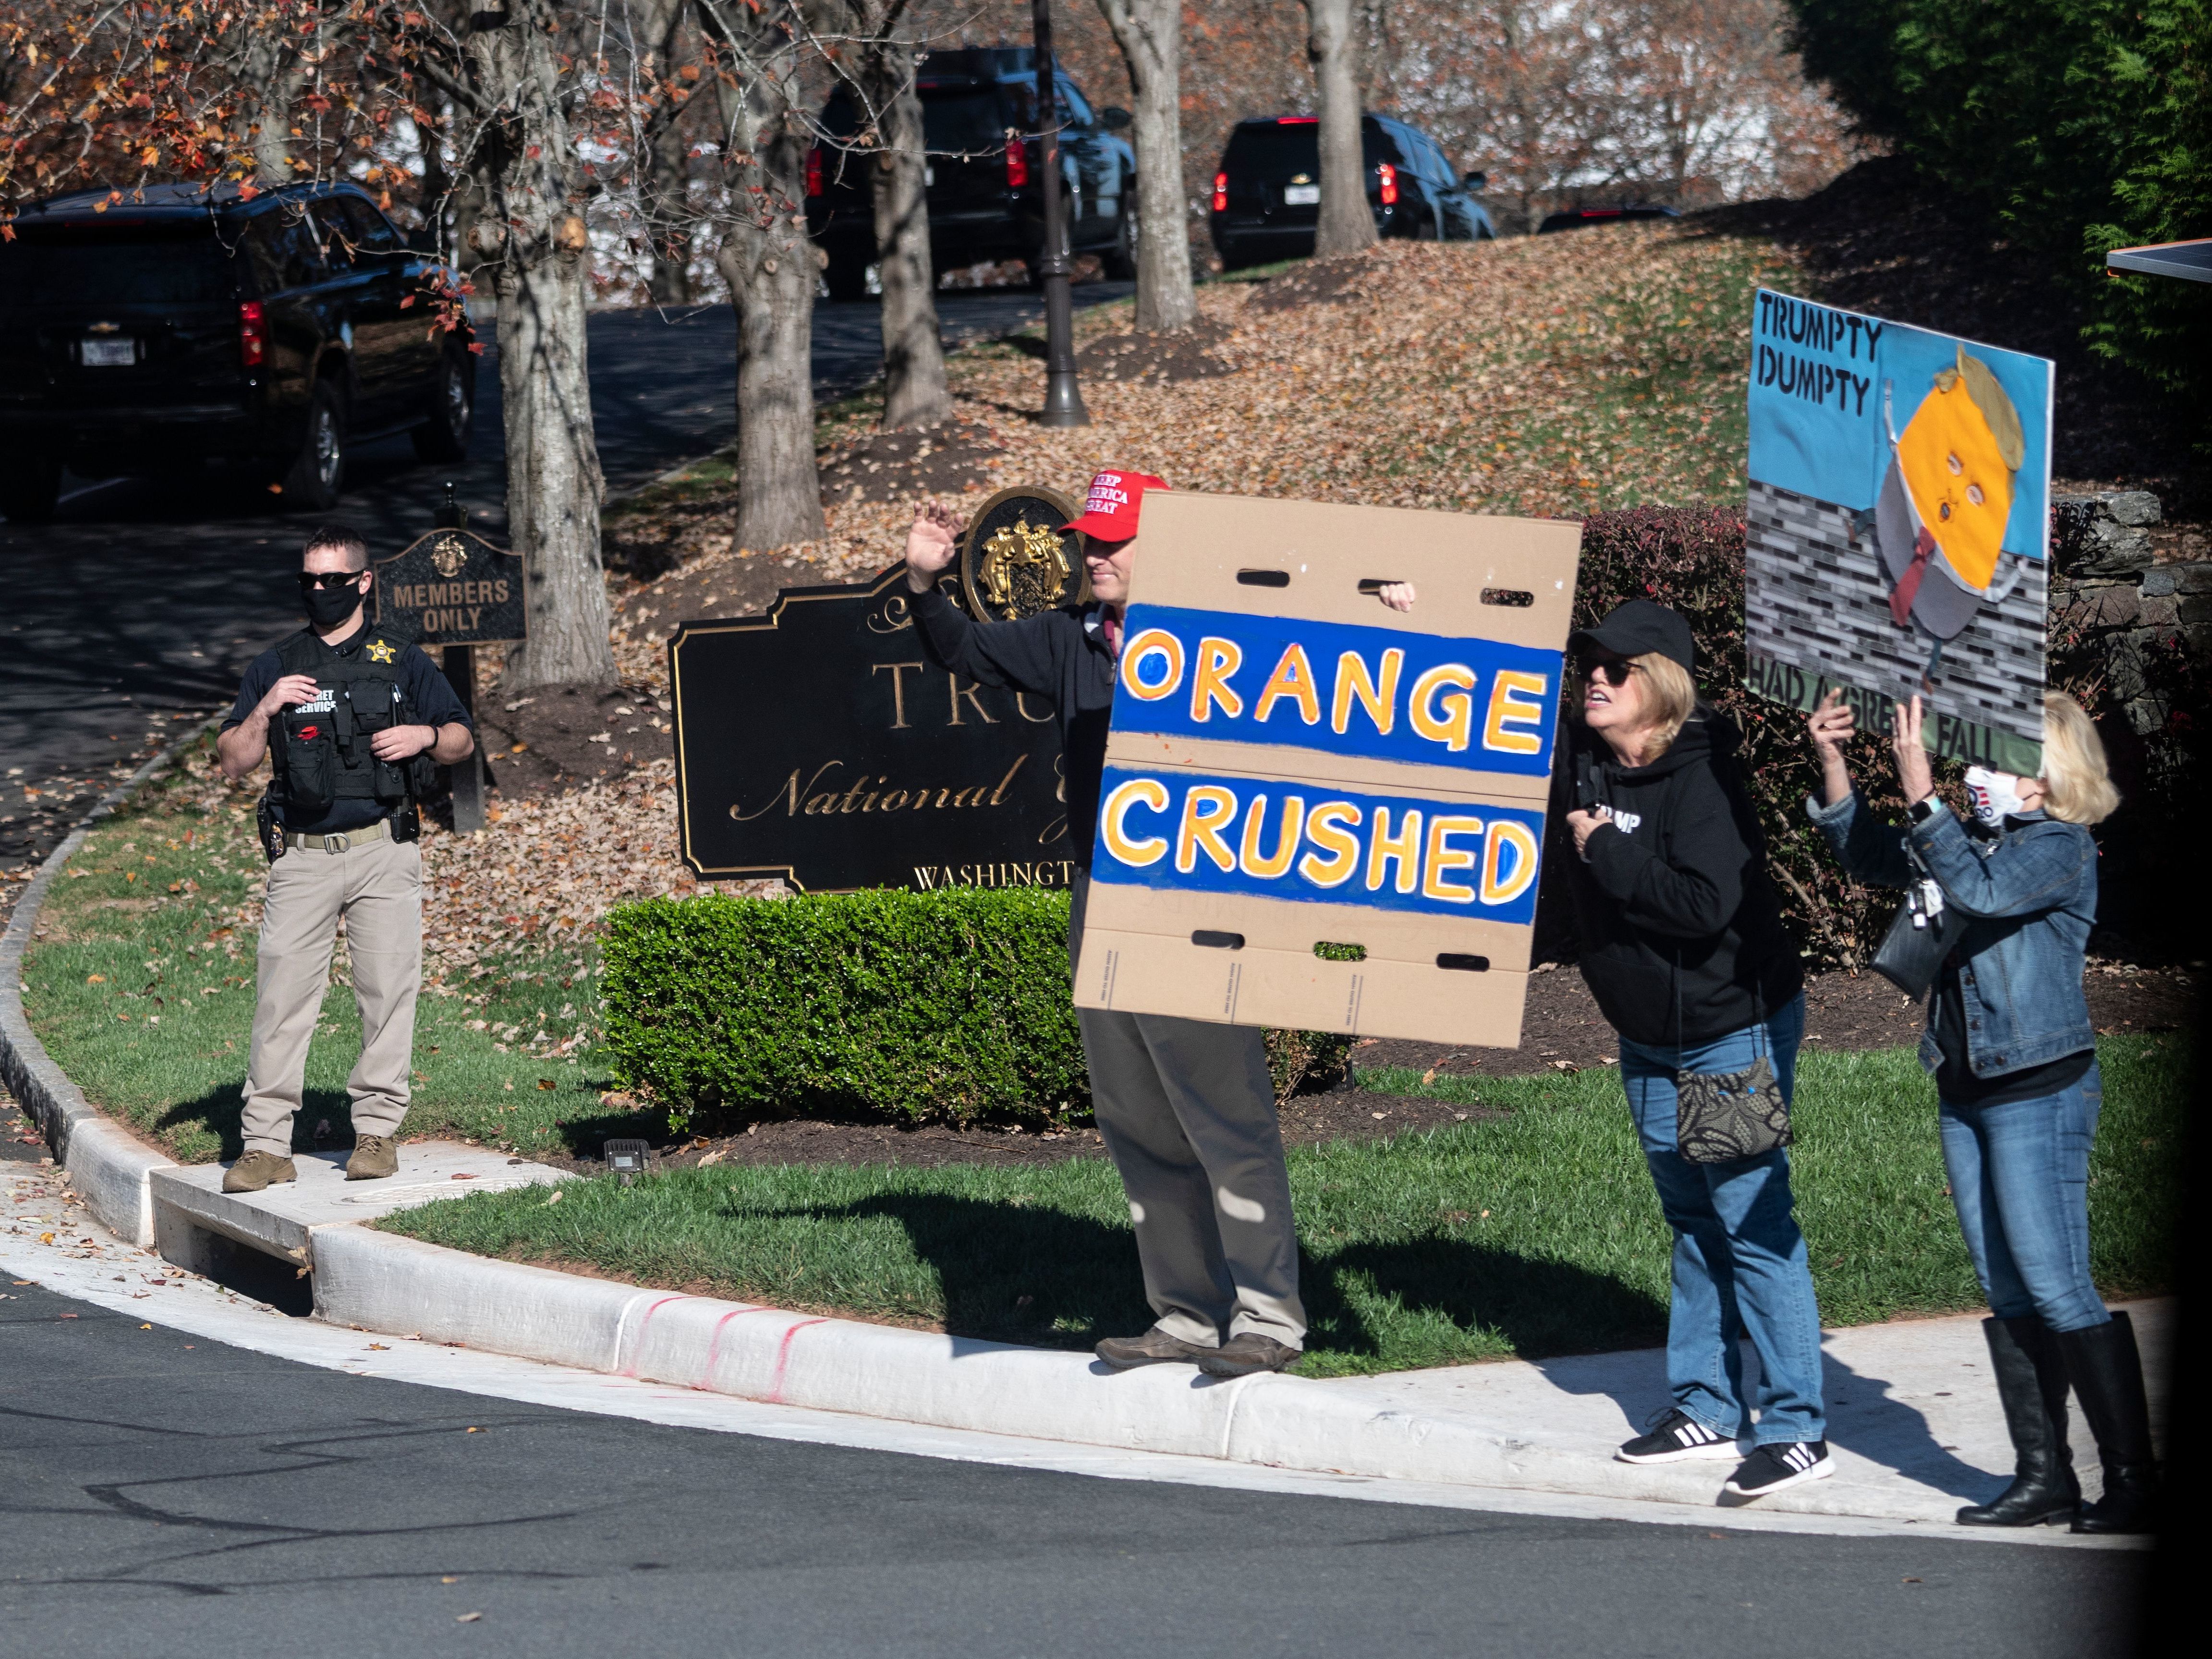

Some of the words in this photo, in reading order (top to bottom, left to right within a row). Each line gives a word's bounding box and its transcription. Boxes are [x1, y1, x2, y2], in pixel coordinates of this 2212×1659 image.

[1760, 293, 1882, 363] TRUMPTY
[1758, 344, 1870, 417] DUMPTY
[393, 579, 510, 608] MEMBERS
[423, 606, 482, 633] ONLY
[872, 661, 1056, 729] TRU
[1121, 628, 1547, 755] ORANGE
[1749, 652, 1805, 709] HAD
[1937, 712, 1997, 773] FALL
[729, 752, 1030, 821] National
[913, 860, 1075, 890] WASHINGT
[1101, 778, 1539, 906] CRUSHED
